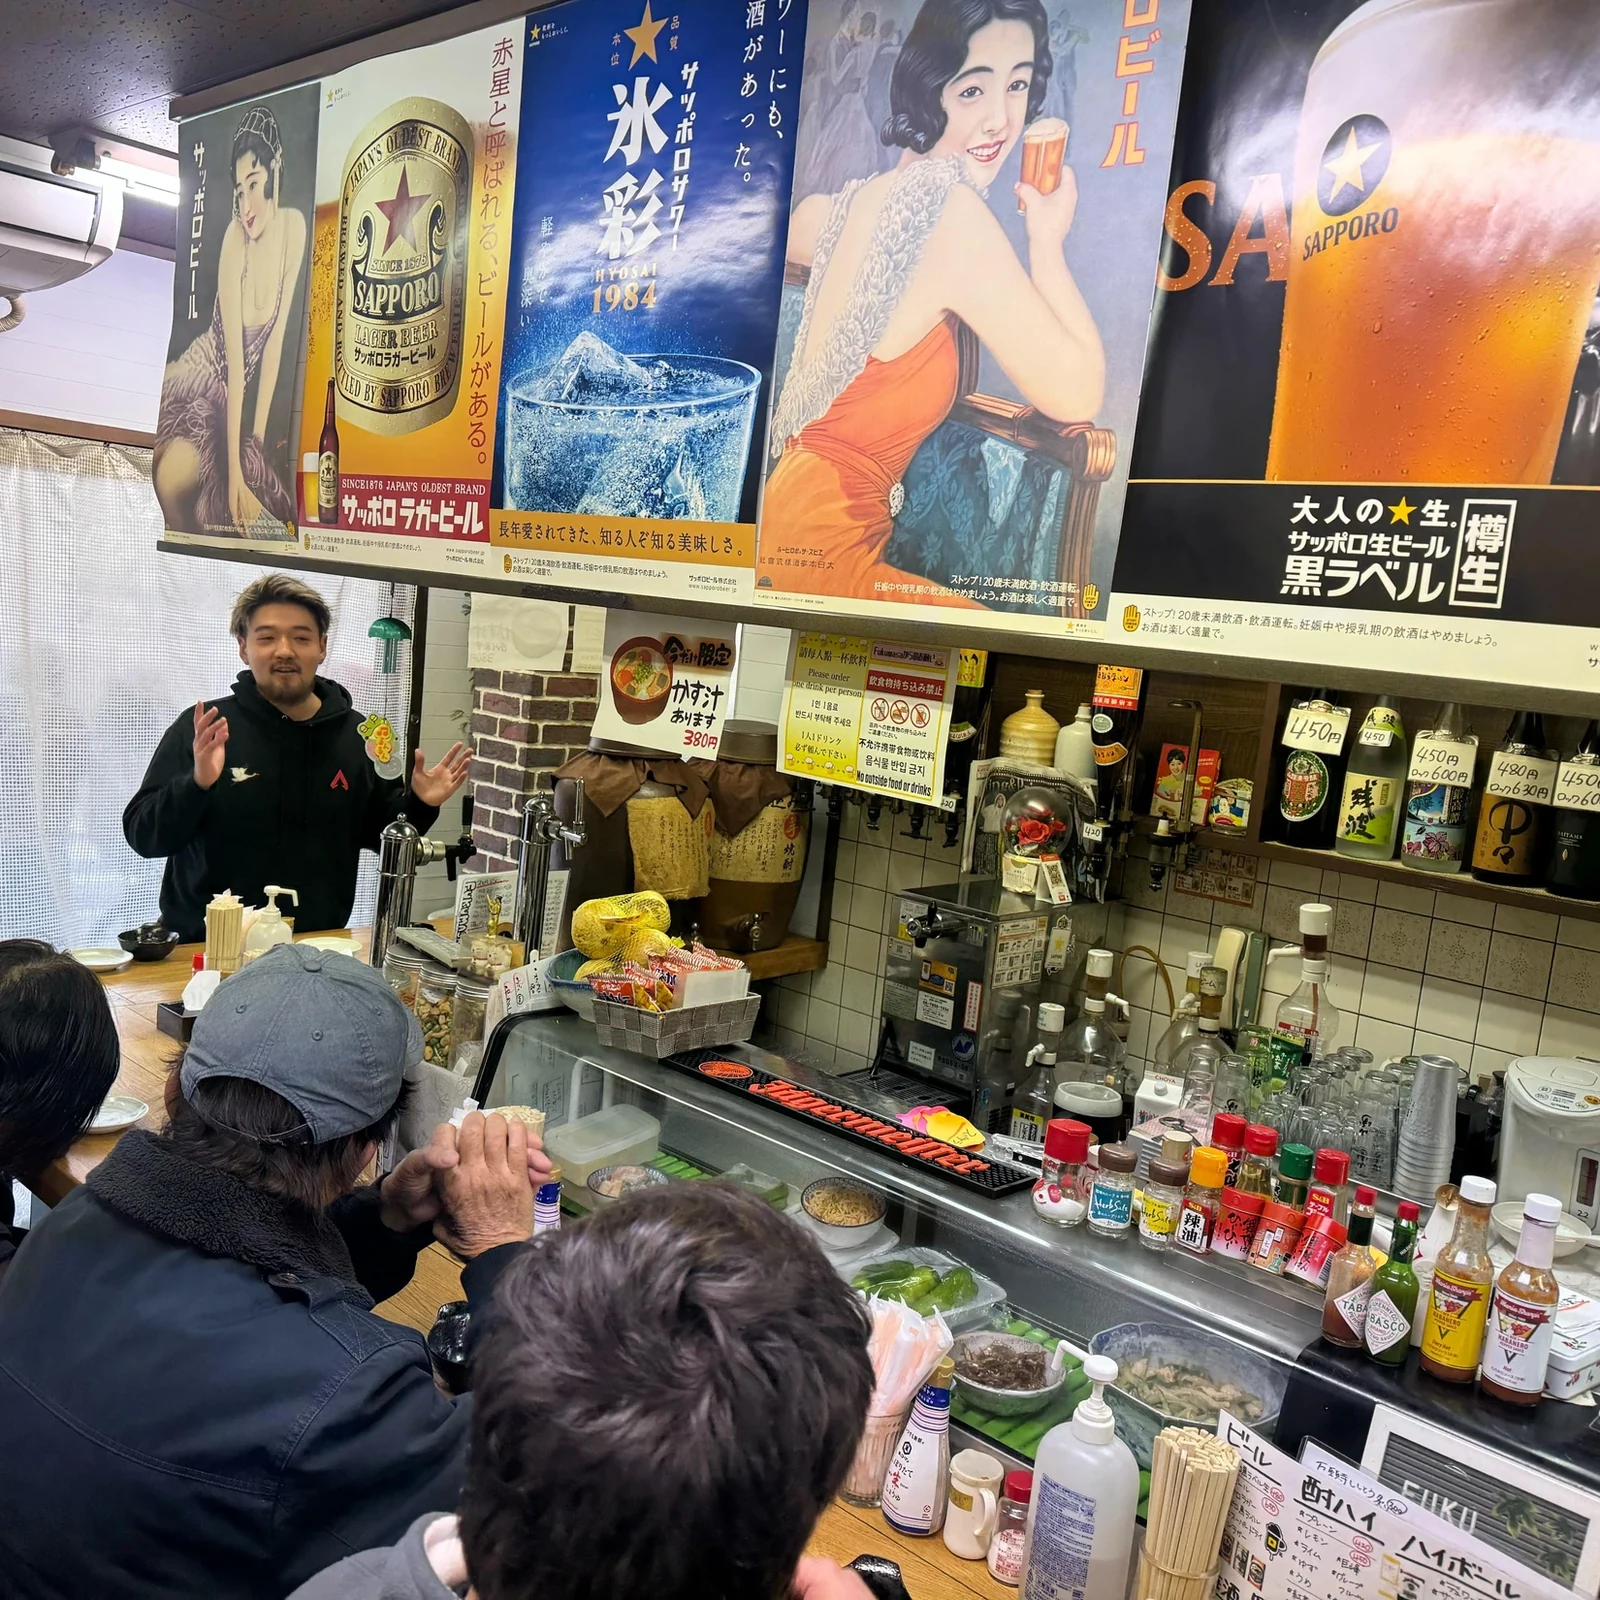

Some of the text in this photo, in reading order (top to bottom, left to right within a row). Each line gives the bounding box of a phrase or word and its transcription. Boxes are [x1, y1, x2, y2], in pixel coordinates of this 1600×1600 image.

[671, 60, 700, 251] サッポロサワー
[595, 76, 674, 261] 氷彩
[187, 141, 206, 320] サッポロビール
[1302, 207, 1399, 261] SAPPORO
[467, 36, 514, 465] 赤星と呼ばれる、ビールがある。
[370, 258, 402, 273] SINCE
[595, 262, 658, 283] HYOSAI
[354, 271, 440, 316] SAPPORO
[591, 280, 658, 314] 1984
[354, 319, 438, 349] LAGER BEER
[354, 344, 437, 368] サッポロラガービール
[380, 379, 430, 408] SAPPORO
[386, 480, 418, 493] JAPAN'S
[420, 482, 452, 495] OLDEST
[454, 483, 486, 496] BRAND
[498, 520, 743, 557] 長年愛されてきた、知る人ぞ知る美味しさ。
[1287, 530, 1451, 560] サッポロ生ビール
[1457, 512, 1508, 596] 樽生
[1279, 556, 1447, 604] 黒ラベル
[1141, 622, 1225, 640] お酒は楽しく適量で。
[808, 668, 850, 682] Please order
[869, 675, 943, 697] 飲食物持ち込み禁止
[671, 679, 724, 711] かす汁
[806, 681, 824, 691] drink
[825, 686, 837, 695] per
[670, 707, 717, 729] あります
[795, 710, 813, 721] 반드시
[834, 716, 852, 728] 주세요
[683, 729, 718, 749] 380円
[1289, 719, 1342, 744] 450円
[1364, 731, 1385, 743] 450
[865, 755, 926, 778] 음식물 반입 금지
[1416, 747, 1459, 767] 450円
[865, 772, 887, 787] outside
[888, 777, 903, 791] food
[903, 782, 911, 792] or
[1497, 761, 1539, 780] 480円
[1084, 825, 1101, 838] 420
[1155, 1074, 1177, 1085] CHOYA
[1312, 1192, 1330, 1205] S&B
[1181, 1212, 1202, 1244] 辣油
[1432, 1312, 1461, 1327] HABANERO
[1498, 1335, 1529, 1350] HABANERO
[1226, 1422, 1272, 1467] ビール
[1301, 1474, 1377, 1533] 酎ハイ
[1304, 1511, 1338, 1534] プレーン
[1304, 1531, 1329, 1546] レモン
[1400, 1535, 1521, 1599] ハイボール
